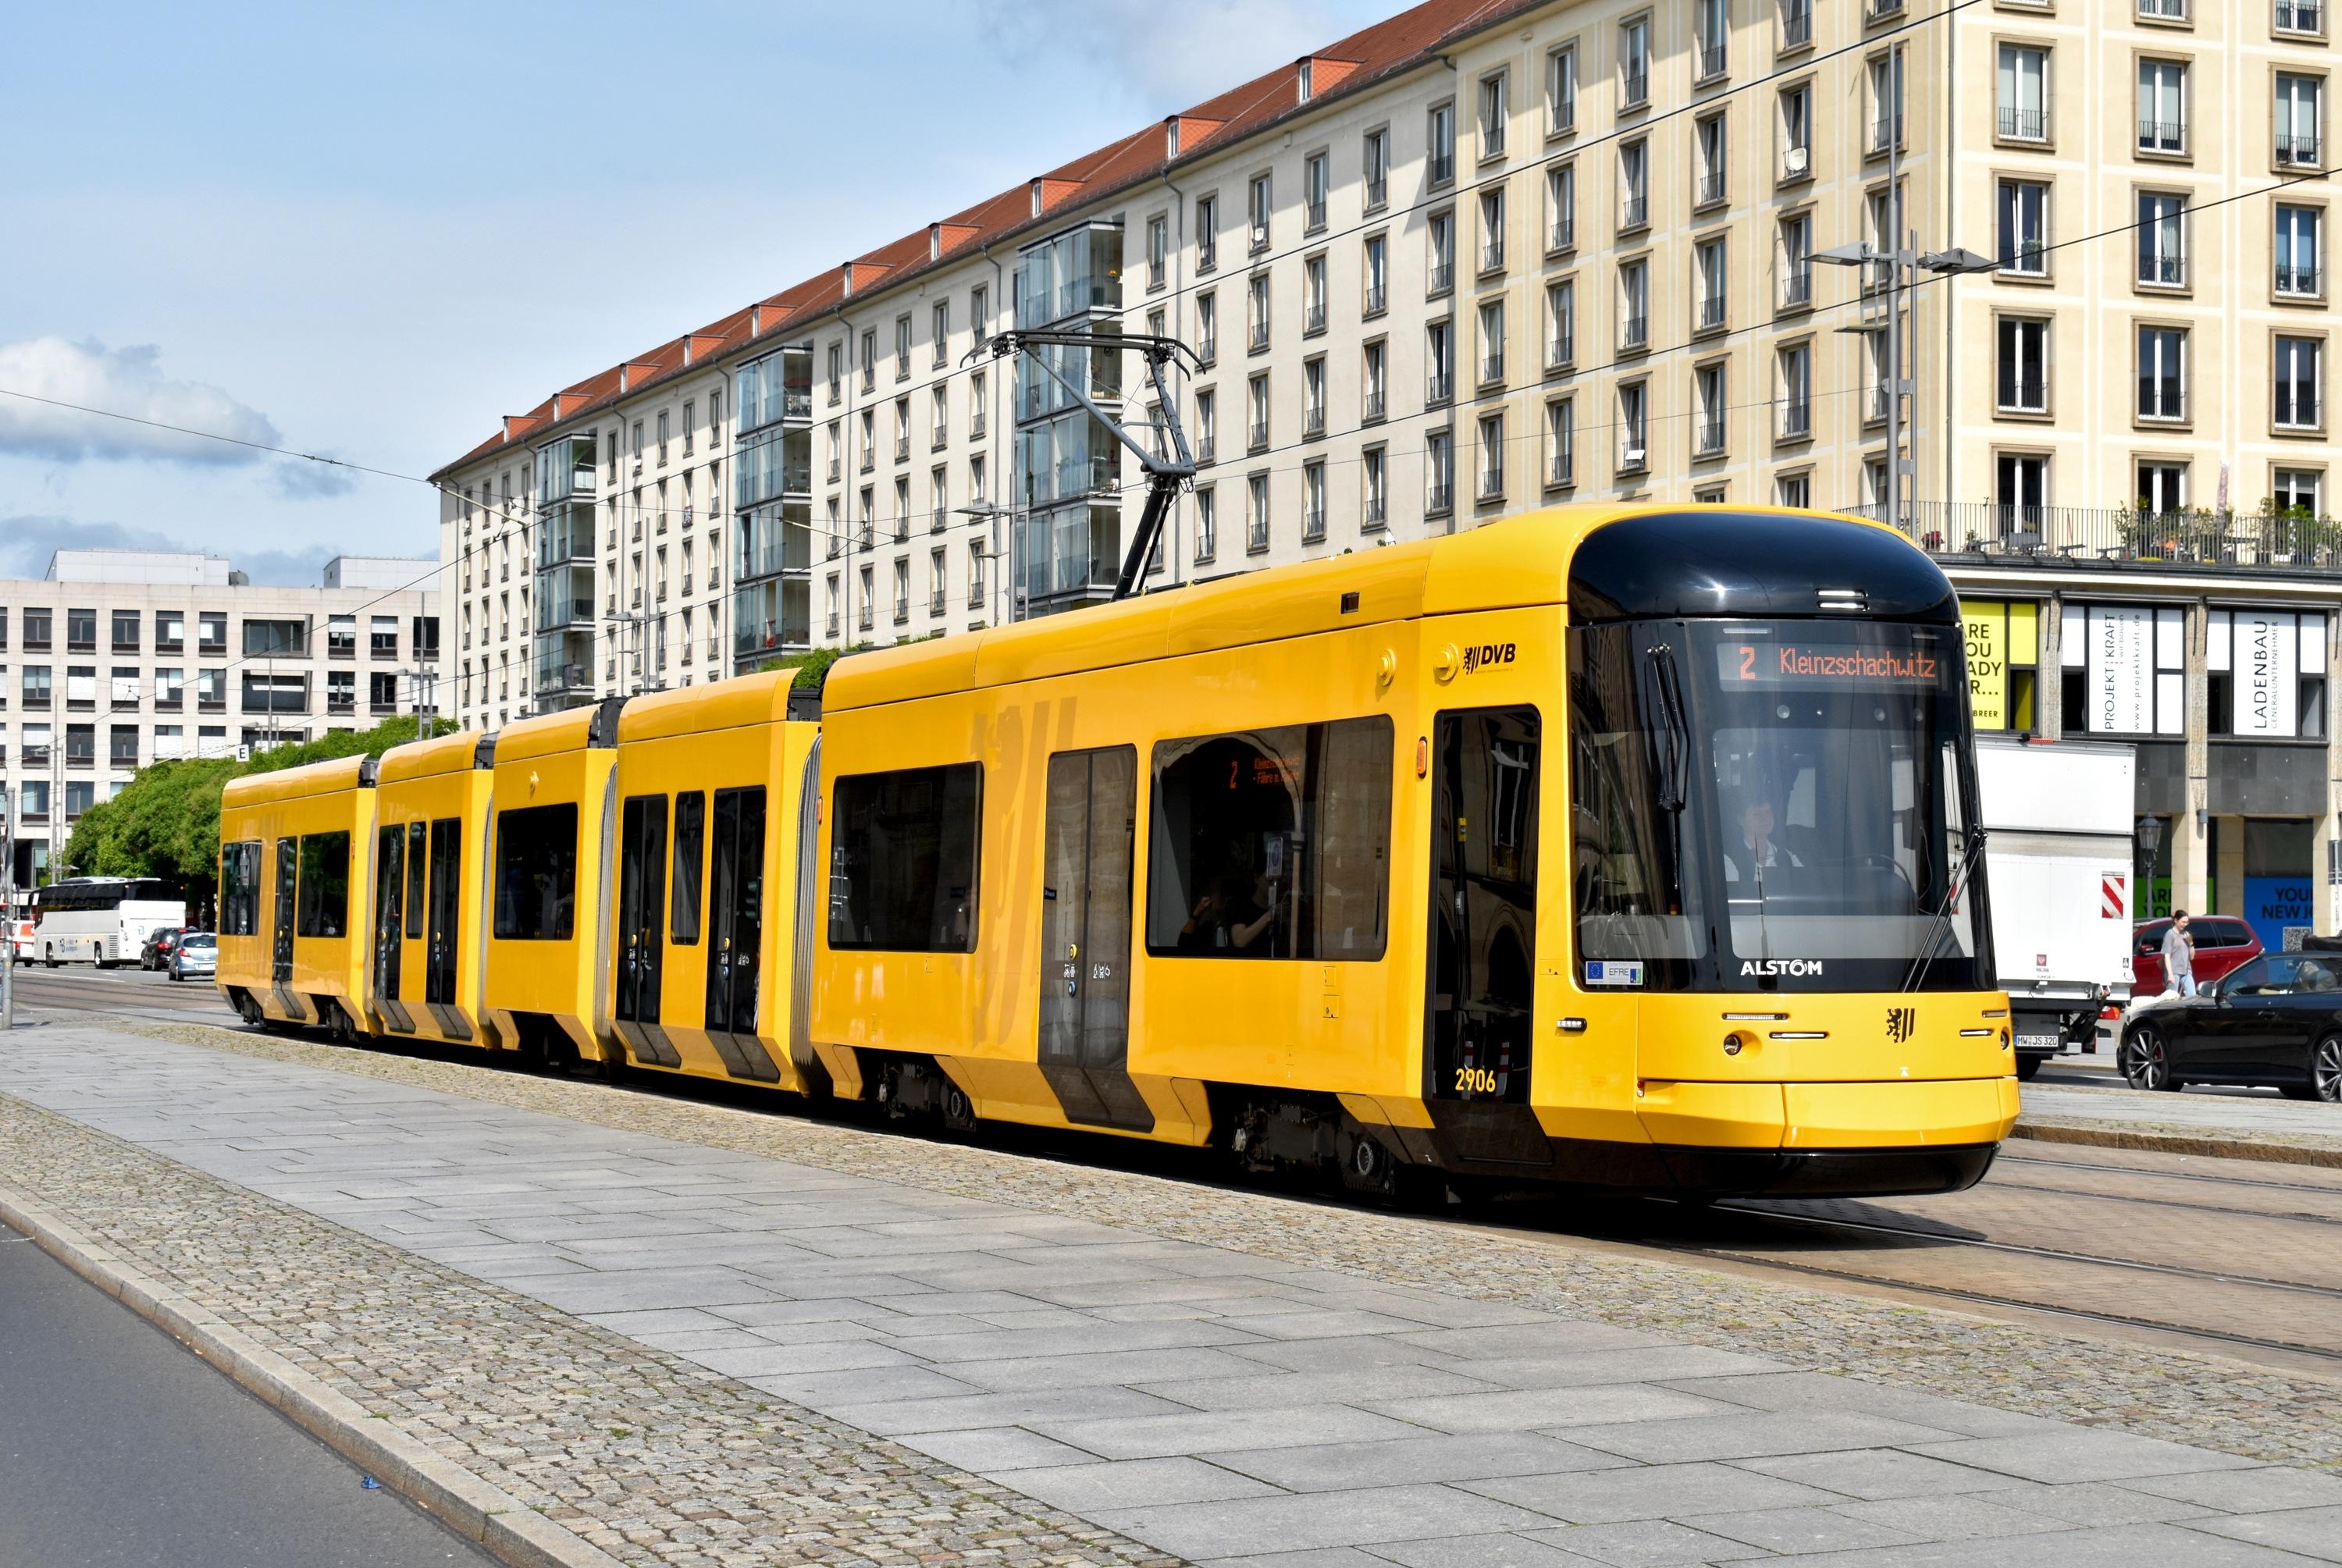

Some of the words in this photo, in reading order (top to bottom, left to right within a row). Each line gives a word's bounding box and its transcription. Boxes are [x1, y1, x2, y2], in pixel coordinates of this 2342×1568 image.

[1964, 624, 1990, 638] RE
[2105, 613, 2115, 658] KRAFT
[1480, 643, 1516, 665] DVB
[1966, 642, 1991, 657] OU
[1739, 646, 1756, 681] 2
[1779, 648, 1936, 677] Kleinzschachwitz
[1968, 661, 2002, 677] ADY
[2133, 614, 2141, 730] www.projektkraft.de
[2254, 620, 2268, 728] LADENBAU
[2105, 667, 2115, 730] PROJEKT
[239, 748, 246, 759] E
[1230, 760, 1238, 789] 2
[2262, 905, 2301, 919] NEW
[1608, 968, 1629, 976] EFRE
[1740, 959, 1823, 976] ALSTOM
[2043, 1036, 2057, 1046] 320
[1455, 1068, 1496, 1093] 2906
